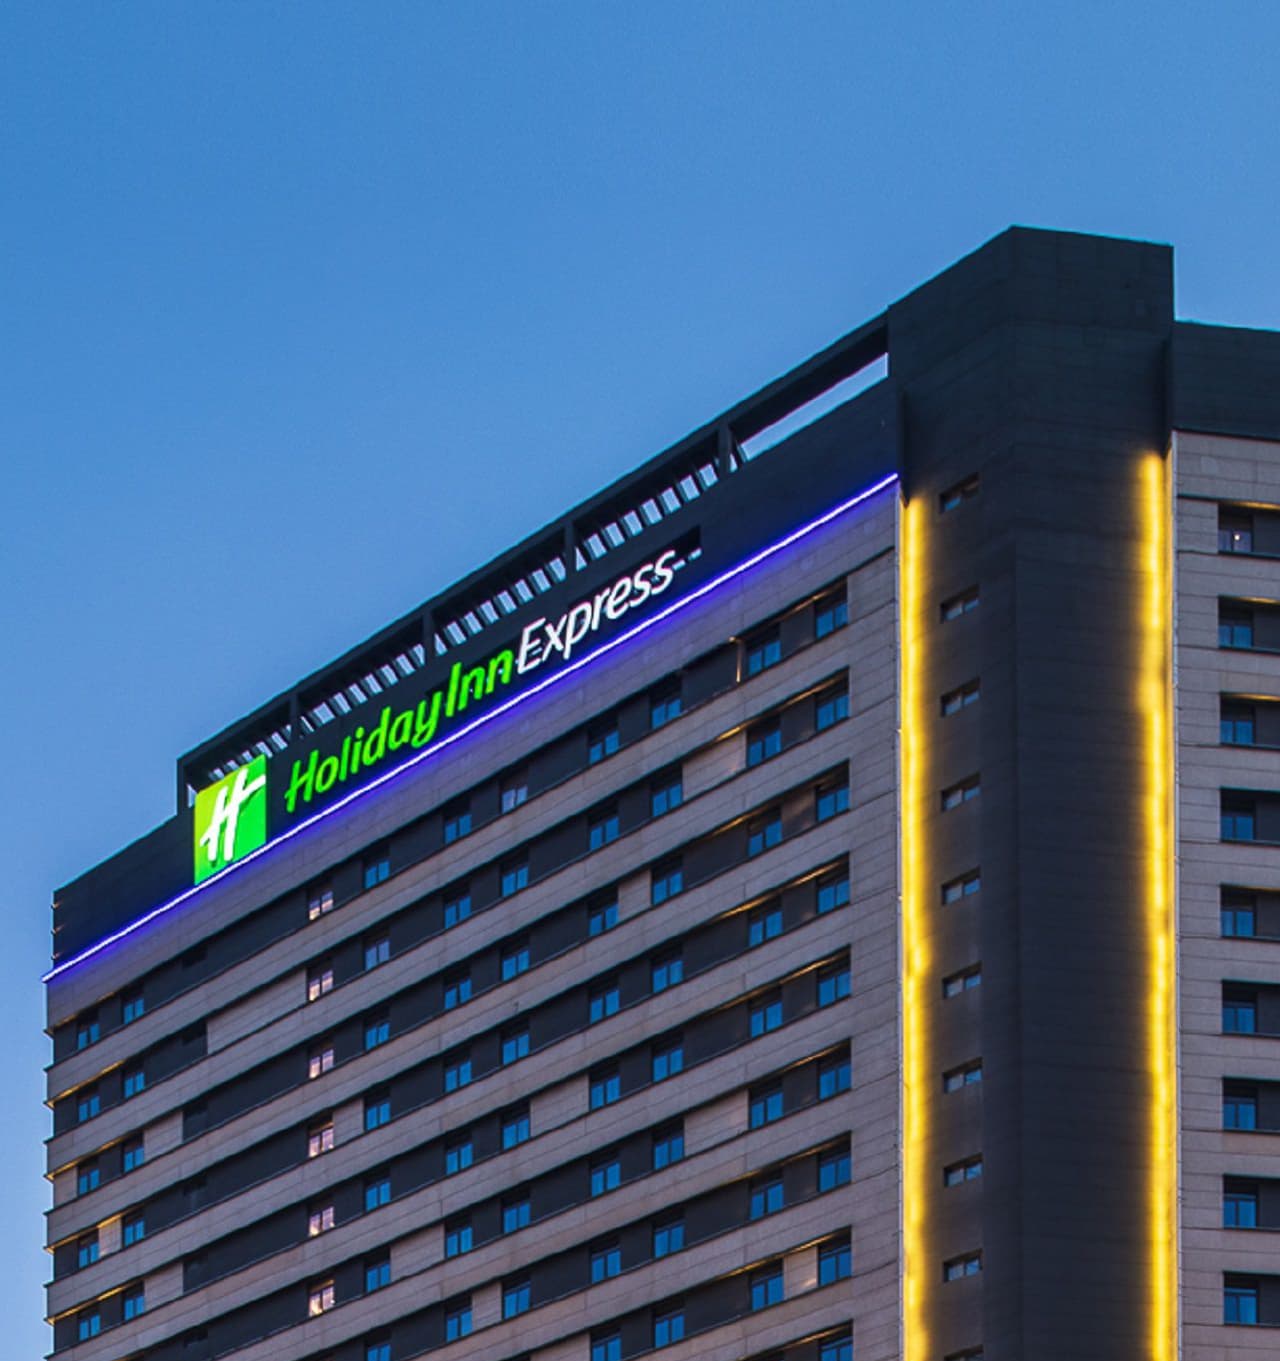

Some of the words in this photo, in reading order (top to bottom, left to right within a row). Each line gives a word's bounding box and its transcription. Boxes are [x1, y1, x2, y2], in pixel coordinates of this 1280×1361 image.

[283, 690, 442, 813] Holiday
[444, 648, 514, 718] Inn
[517, 549, 678, 676] Express
